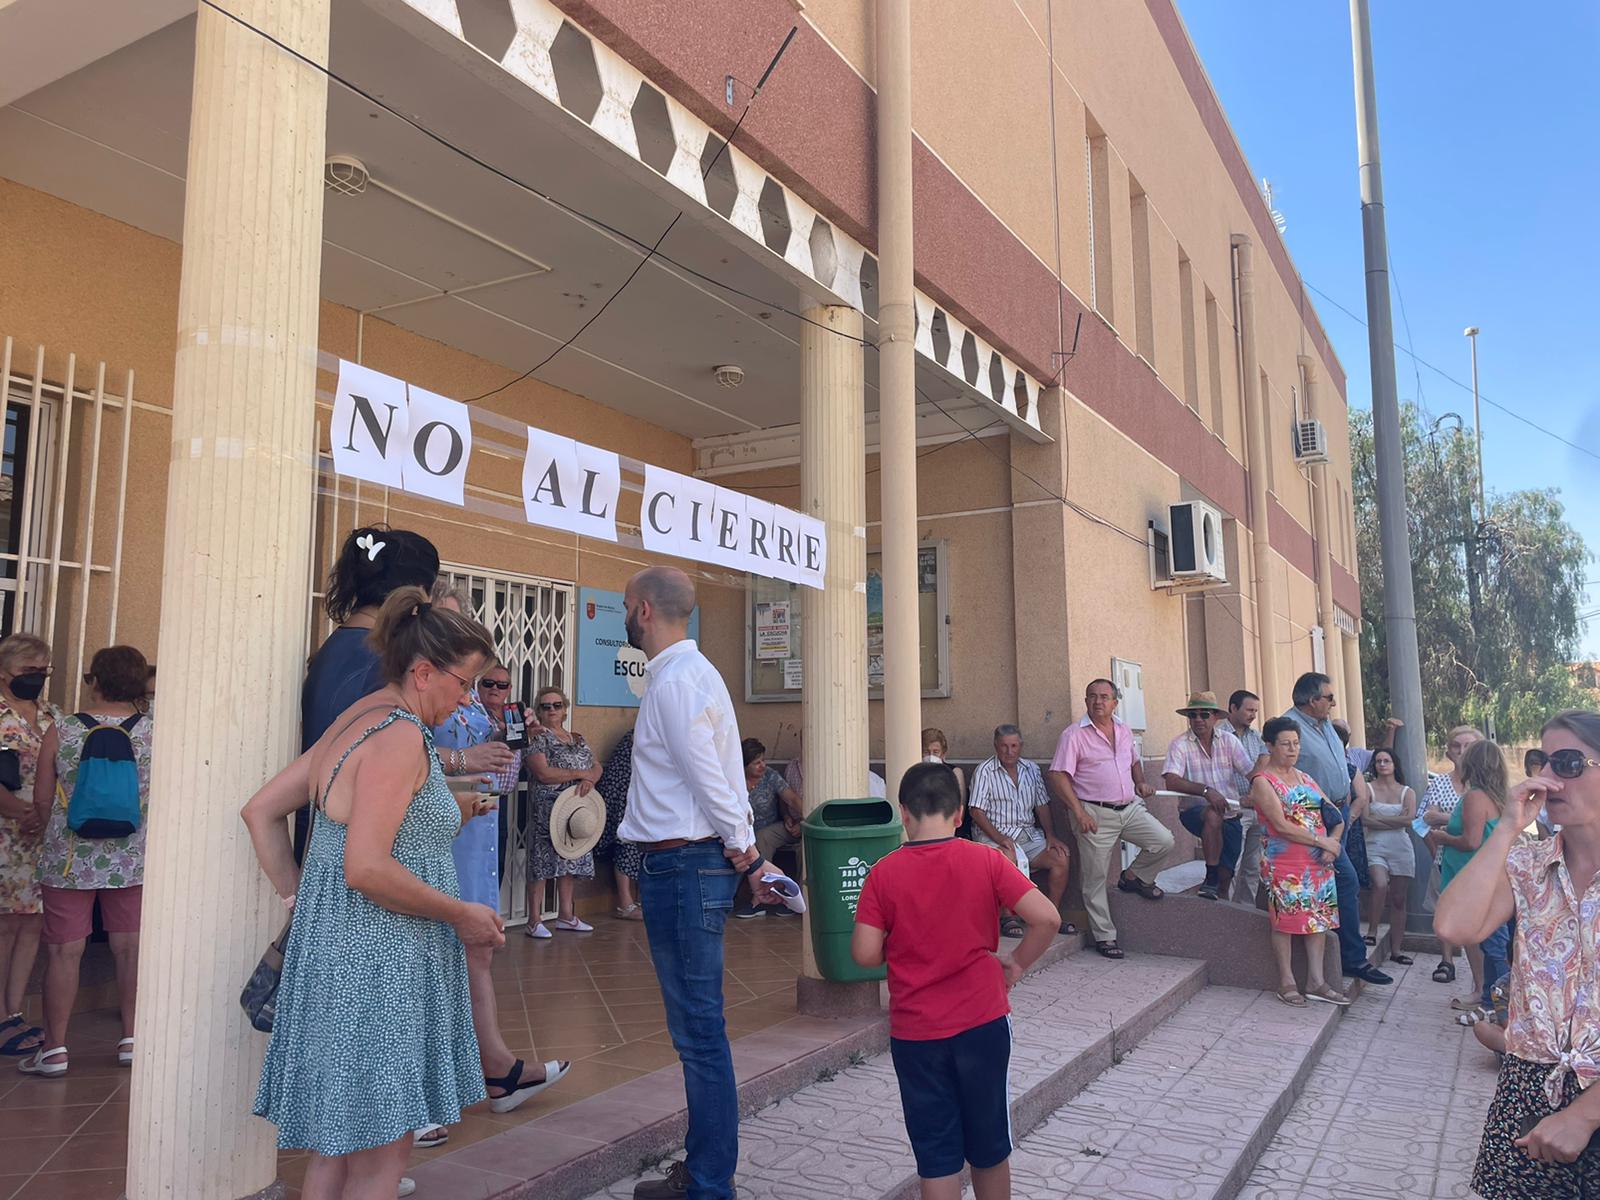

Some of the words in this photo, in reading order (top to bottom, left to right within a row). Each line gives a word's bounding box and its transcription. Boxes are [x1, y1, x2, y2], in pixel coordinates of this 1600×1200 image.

[342, 393, 463, 476] NO
[531, 458, 609, 519] AL
[648, 491, 821, 572] CIERRE
